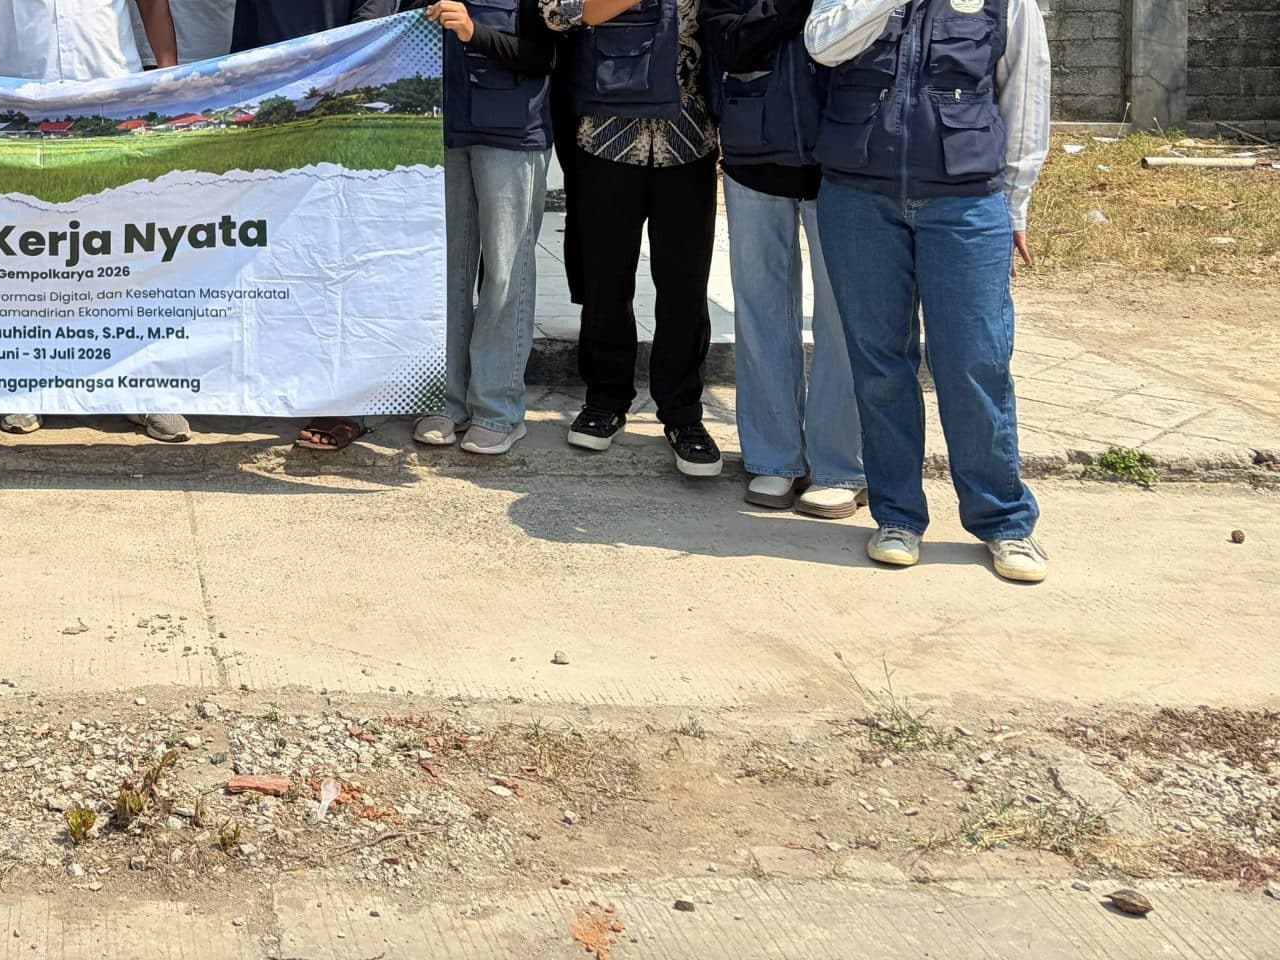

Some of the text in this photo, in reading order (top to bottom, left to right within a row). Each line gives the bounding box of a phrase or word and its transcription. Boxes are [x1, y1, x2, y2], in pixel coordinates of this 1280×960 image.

[124, 215, 268, 262] Nyata
[97, 266, 131, 278] 2026
[50, 291, 94, 304] Digital,
[97, 289, 122, 300] dan
[126, 288, 196, 300] Kesehatan
[78, 307, 133, 318] Ekonomi
[137, 306, 232, 320] Berkelanjutan"
[55, 327, 99, 341] Abas,
[102, 327, 144, 341] S.Pd.,
[147, 327, 190, 339] M.Pd.
[33, 348, 47, 360] 31
[50, 347, 75, 360] Juli
[78, 348, 112, 360] 2026
[118, 375, 201, 392] Karawang
